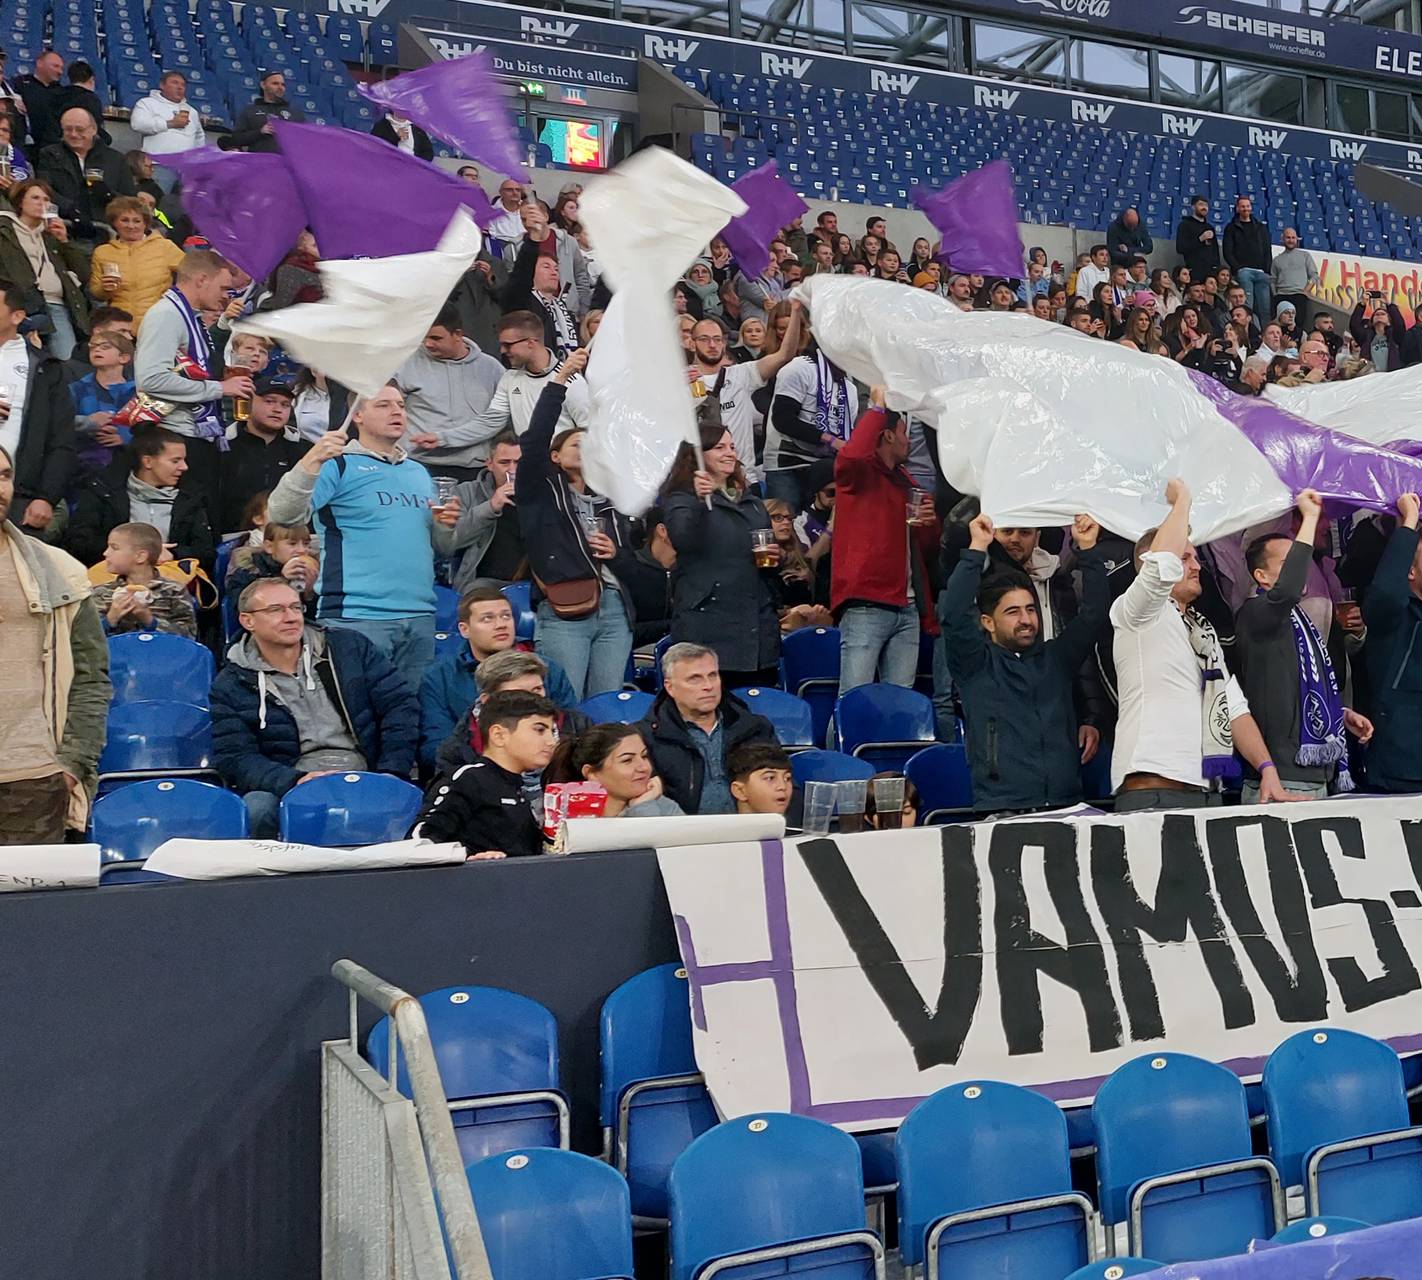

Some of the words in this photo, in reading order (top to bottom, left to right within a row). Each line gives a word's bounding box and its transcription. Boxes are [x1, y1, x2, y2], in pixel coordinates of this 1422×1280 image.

[1206, 9, 1326, 47] SCHEFFER
[645, 34, 699, 62] R+V
[1269, 41, 1326, 59] www.scheffer.de
[1376, 45, 1422, 76] ELE
[492, 57, 514, 72] Du
[517, 59, 544, 76] bist
[548, 63, 583, 80] nicht
[586, 68, 629, 86] allein.
[761, 52, 813, 79] R+V
[871, 69, 919, 95] R+V
[974, 85, 1020, 110] R+V
[1072, 100, 1114, 123] R+V
[1162, 114, 1203, 136] R+V
[1249, 127, 1287, 148] R+V
[1330, 139, 1366, 160] R+V
